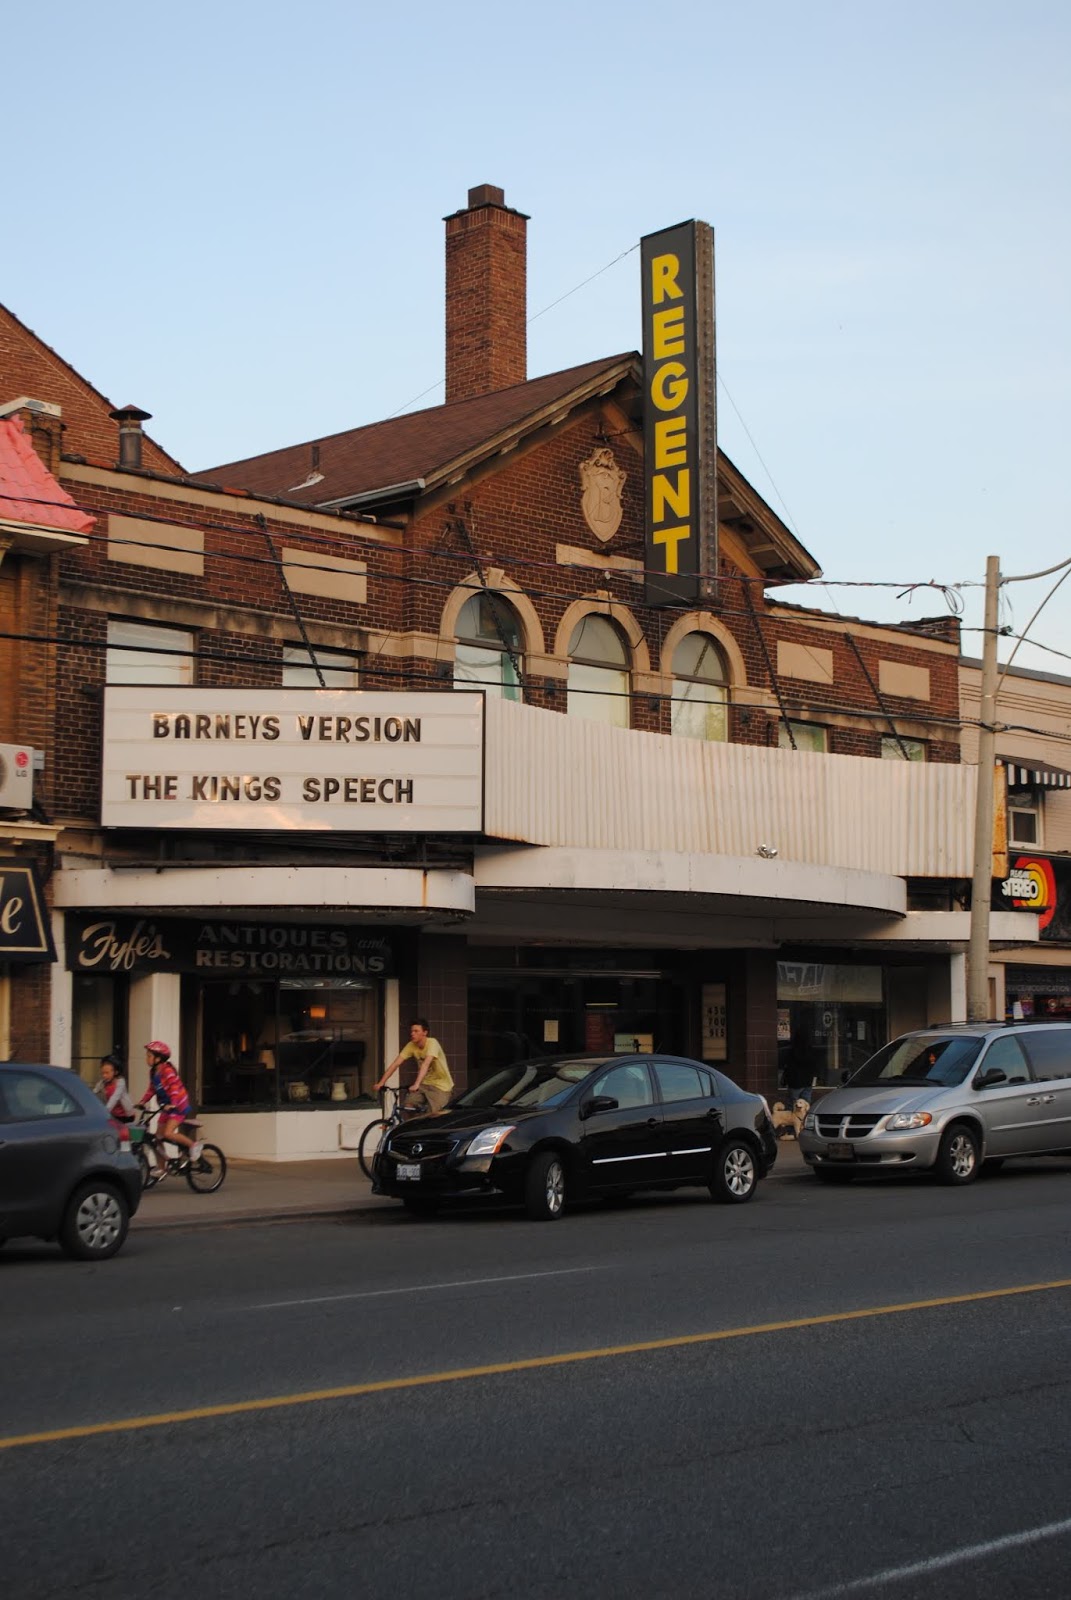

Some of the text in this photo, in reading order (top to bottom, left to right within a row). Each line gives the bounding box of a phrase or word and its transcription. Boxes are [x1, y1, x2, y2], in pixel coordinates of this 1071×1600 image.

[651, 253, 690, 575] REGENT
[152, 713, 422, 743] BARNEYS VERSION
[126, 774, 414, 804] THE KINGS SPEECH
[1001, 878, 1038, 899] STEREO
[78, 922, 171, 971] Fyfe's
[196, 925, 348, 947] ANTIQUES
[195, 949, 385, 972] RESTORATIONS
